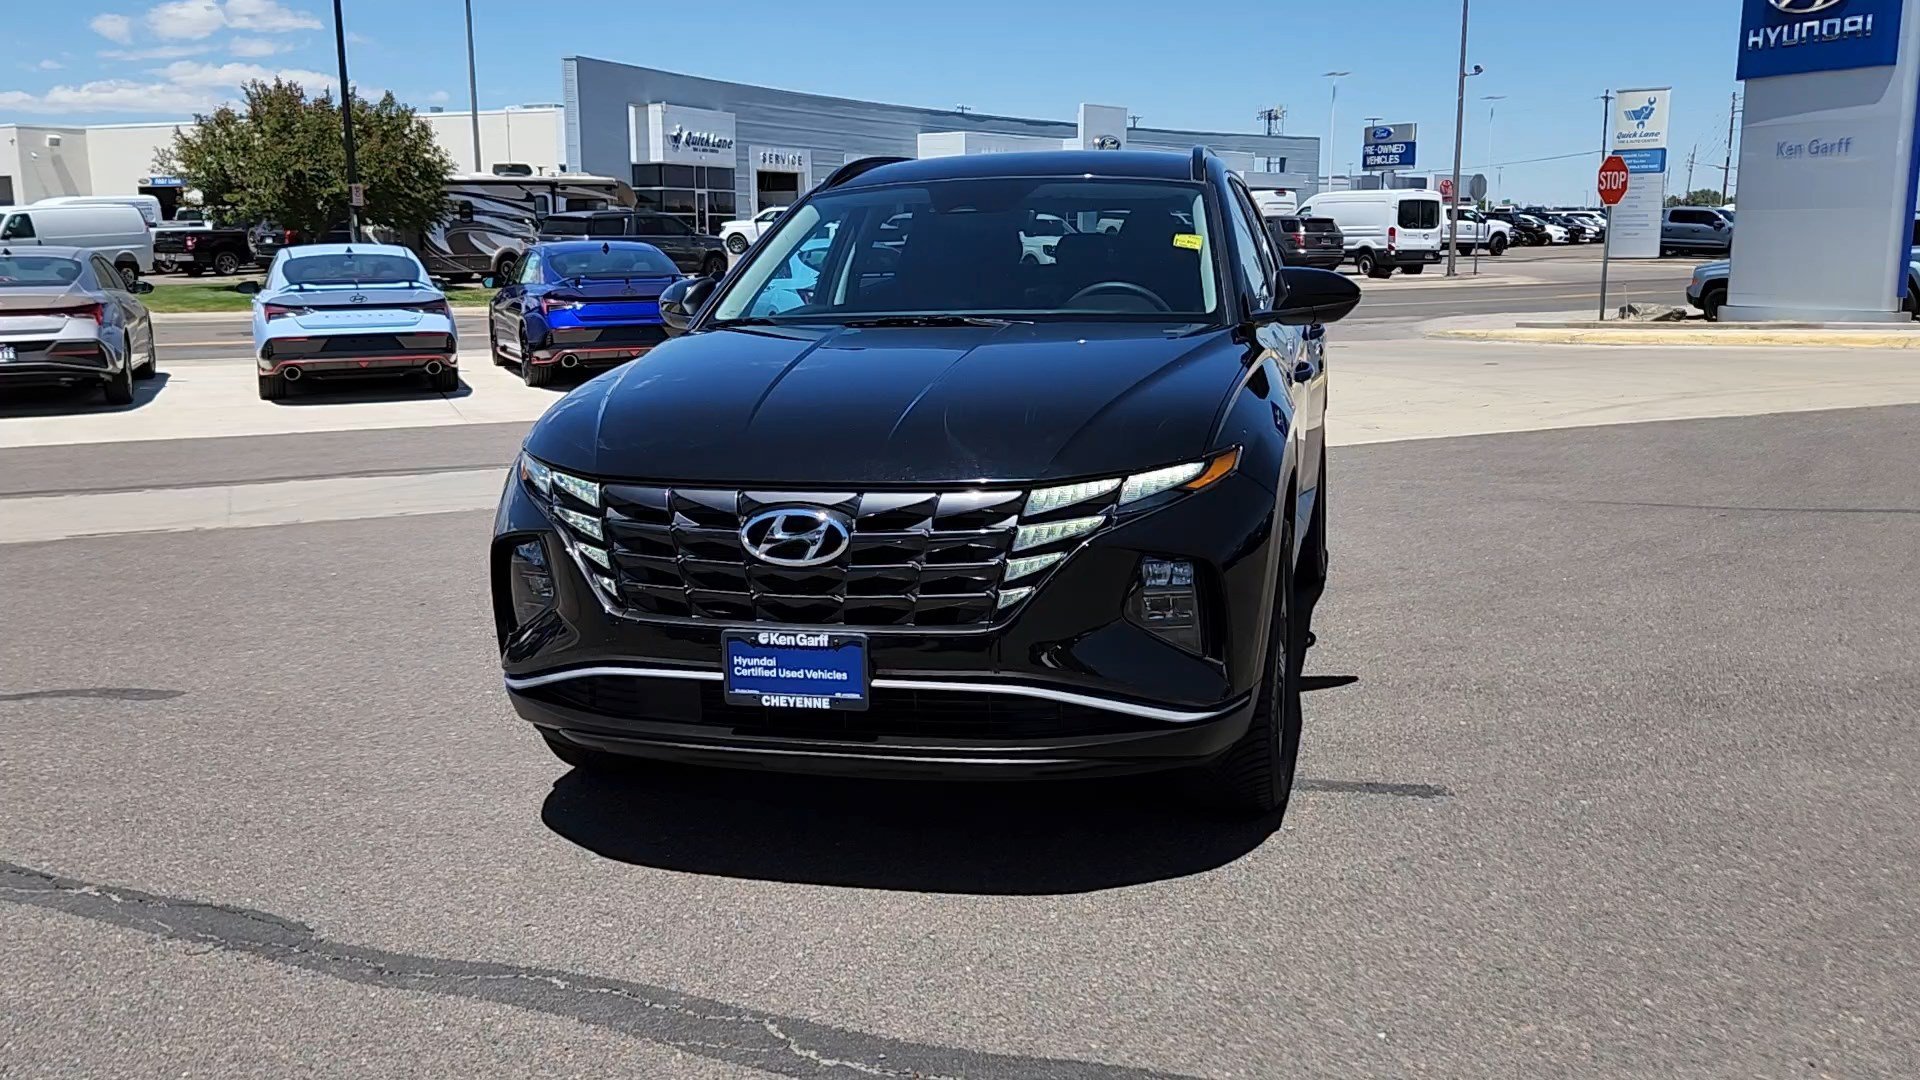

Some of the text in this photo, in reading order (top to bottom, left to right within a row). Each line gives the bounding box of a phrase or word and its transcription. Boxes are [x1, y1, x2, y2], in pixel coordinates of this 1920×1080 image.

[1747, 14, 1873, 50] HYUNDAI
[684, 130, 733, 149] Quick Lane
[1616, 131, 1637, 139] Quick
[1364, 143, 1406, 155] PRE-OWNED
[1776, 137, 1853, 157] Ken Garff
[761, 152, 803, 166] SERVICE
[1366, 154, 1400, 165] VEHICLES
[1599, 171, 1627, 190] STOP
[769, 633, 829, 647] Ken Garff
[733, 655, 776, 667] Hyundai
[734, 666, 848, 680] Certified Used Vehicles
[761, 695, 831, 709] CHEYENNE
